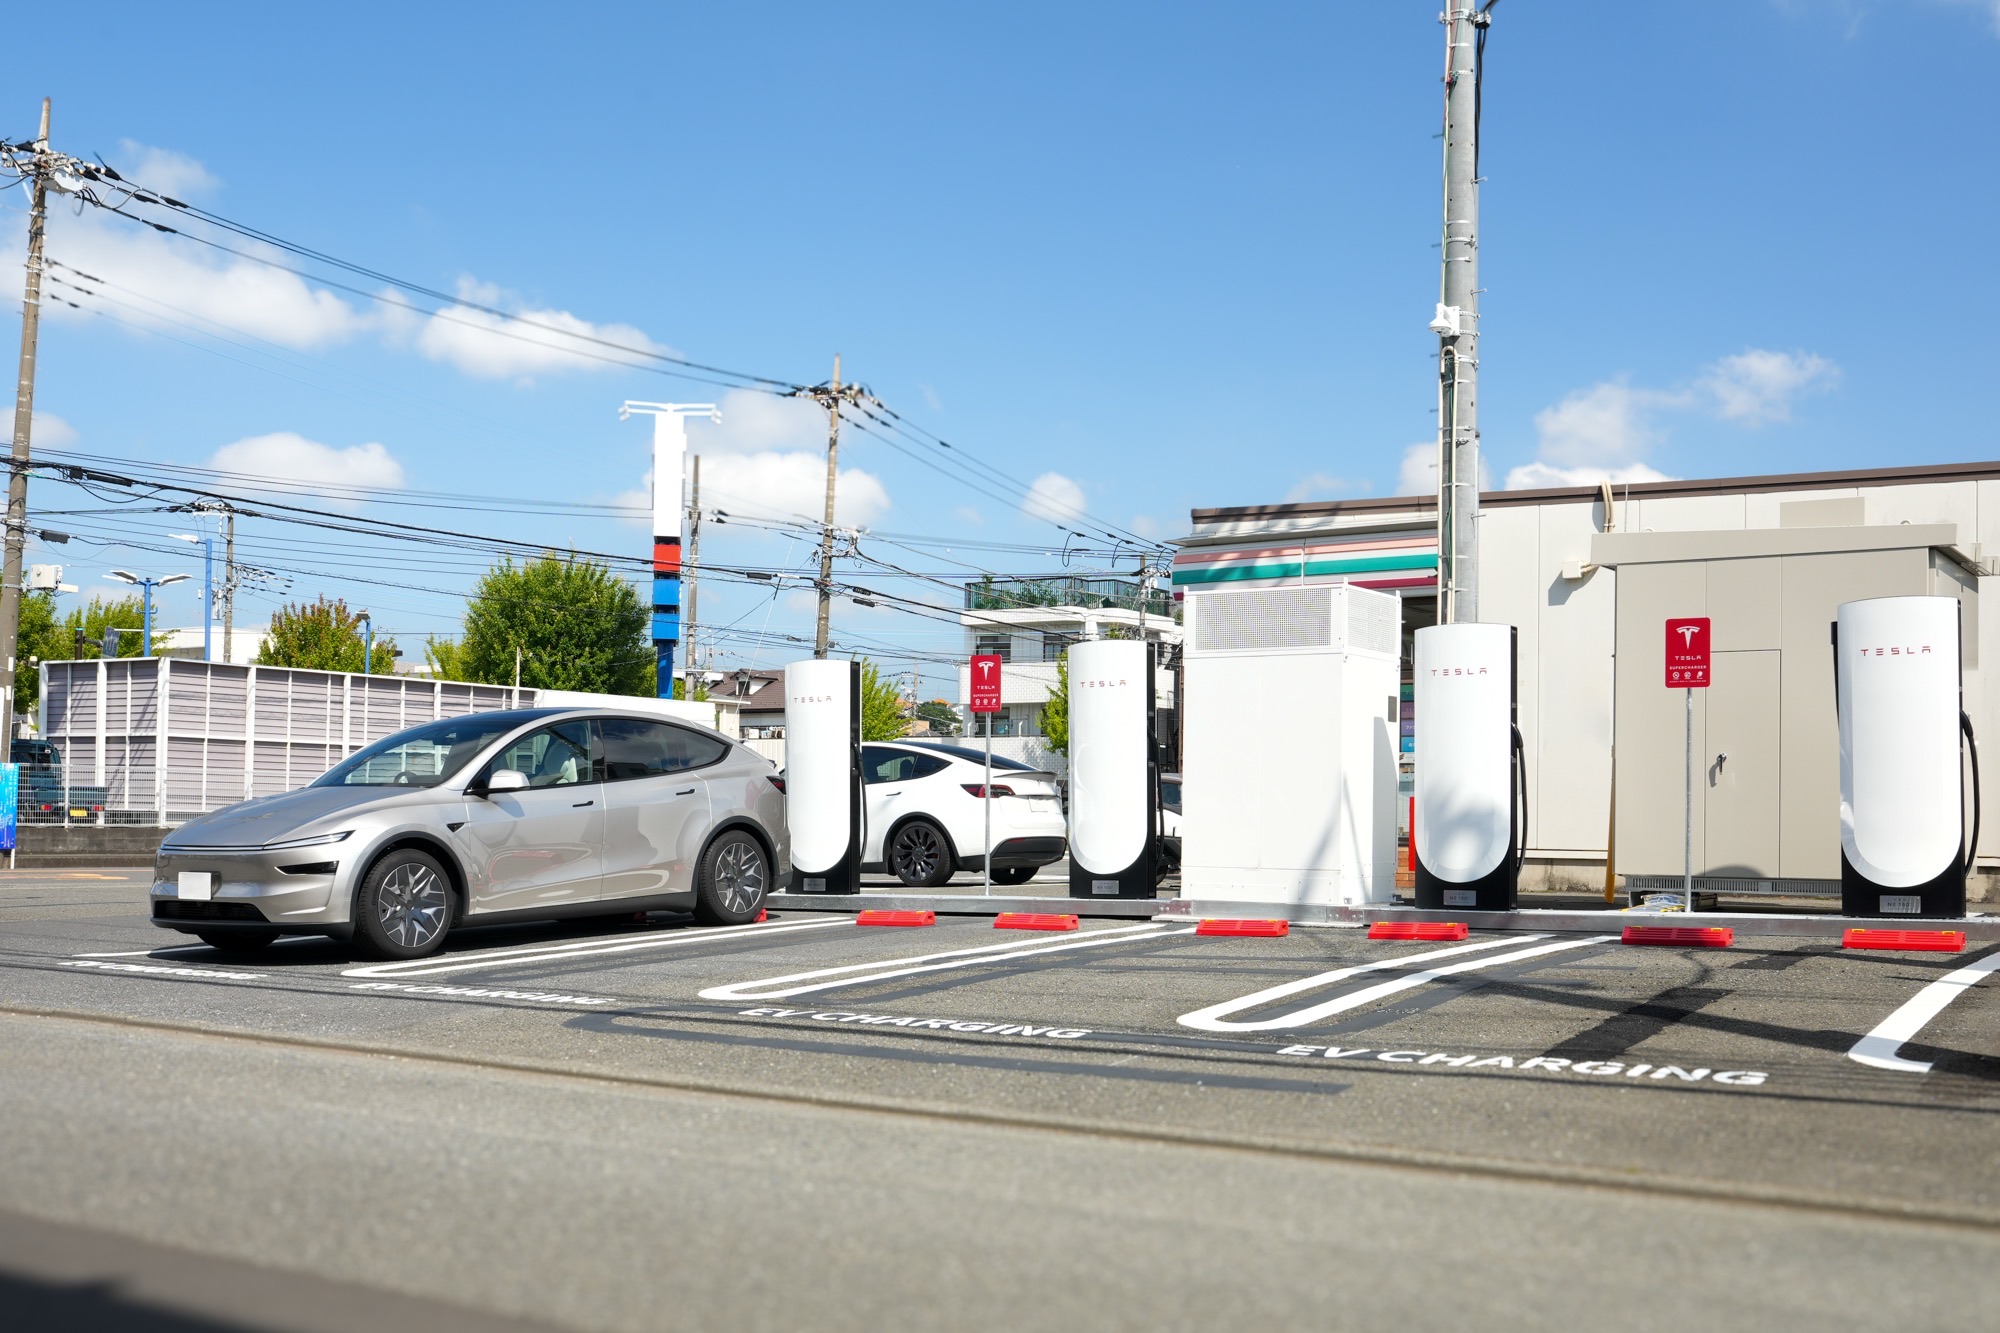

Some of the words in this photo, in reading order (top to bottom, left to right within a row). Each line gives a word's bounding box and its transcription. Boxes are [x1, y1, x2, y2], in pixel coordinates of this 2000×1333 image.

[1860, 646, 1931, 657] TESLA
[1431, 667, 1487, 677] TESLA
[1080, 680, 1127, 688] TESLA
[793, 695, 832, 704] TESLA
[403, 986, 617, 1005] CHARGING
[738, 1007, 818, 1018] EV
[811, 1012, 1093, 1039] CHARGING
[1276, 1044, 1372, 1059] EV
[1376, 1050, 1770, 1086] CHARGING
